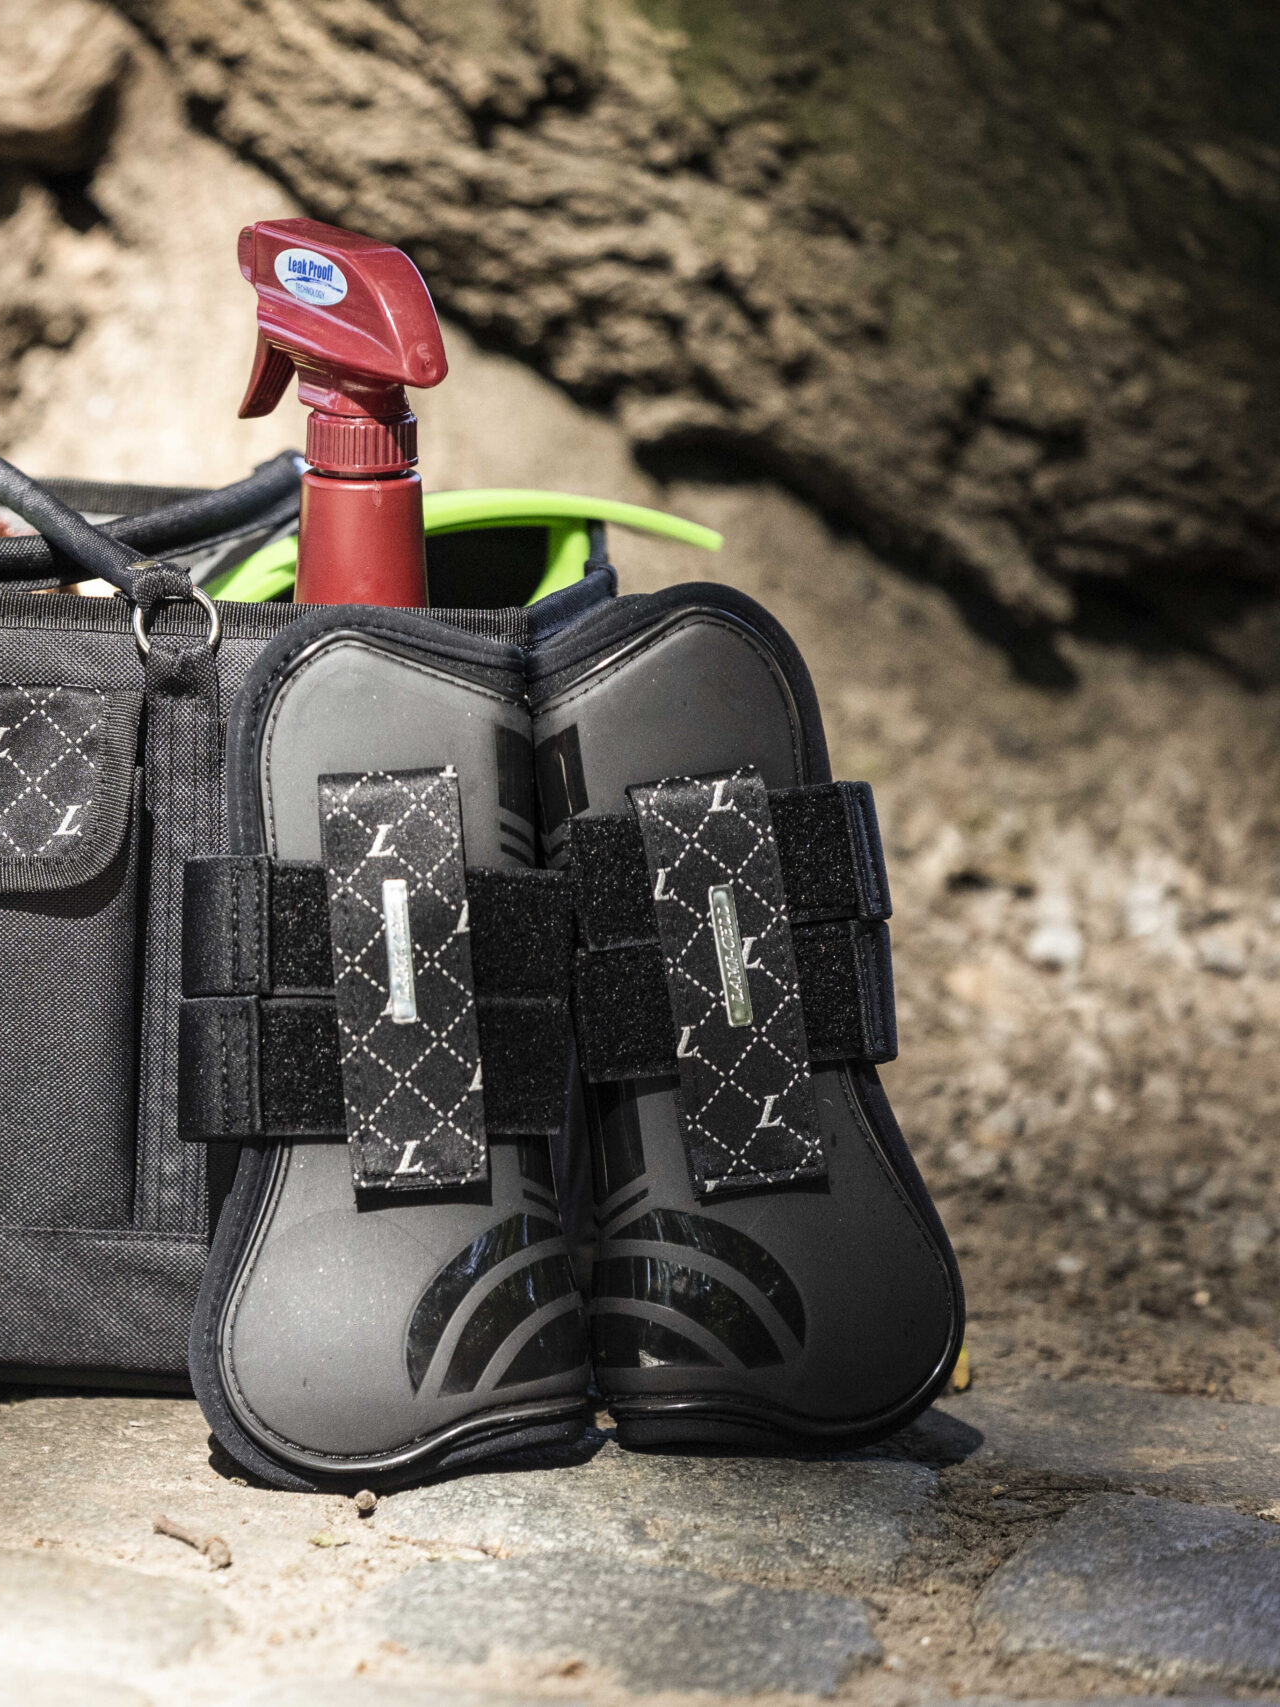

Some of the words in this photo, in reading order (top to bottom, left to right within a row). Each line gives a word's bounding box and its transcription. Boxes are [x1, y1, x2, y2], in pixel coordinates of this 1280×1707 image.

[288, 256, 307, 275] Leak
[296, 282, 325, 300] TECHNOLOGY
[708, 780, 734, 812] L
[52, 805, 83, 836] L
[365, 824, 396, 856] L
[654, 869, 674, 901] L
[716, 906, 745, 1005] LAMI-CELL
[741, 937, 761, 969] L
[676, 1026, 697, 1058] L
[755, 1095, 782, 1129] L
[394, 1140, 424, 1175] L
